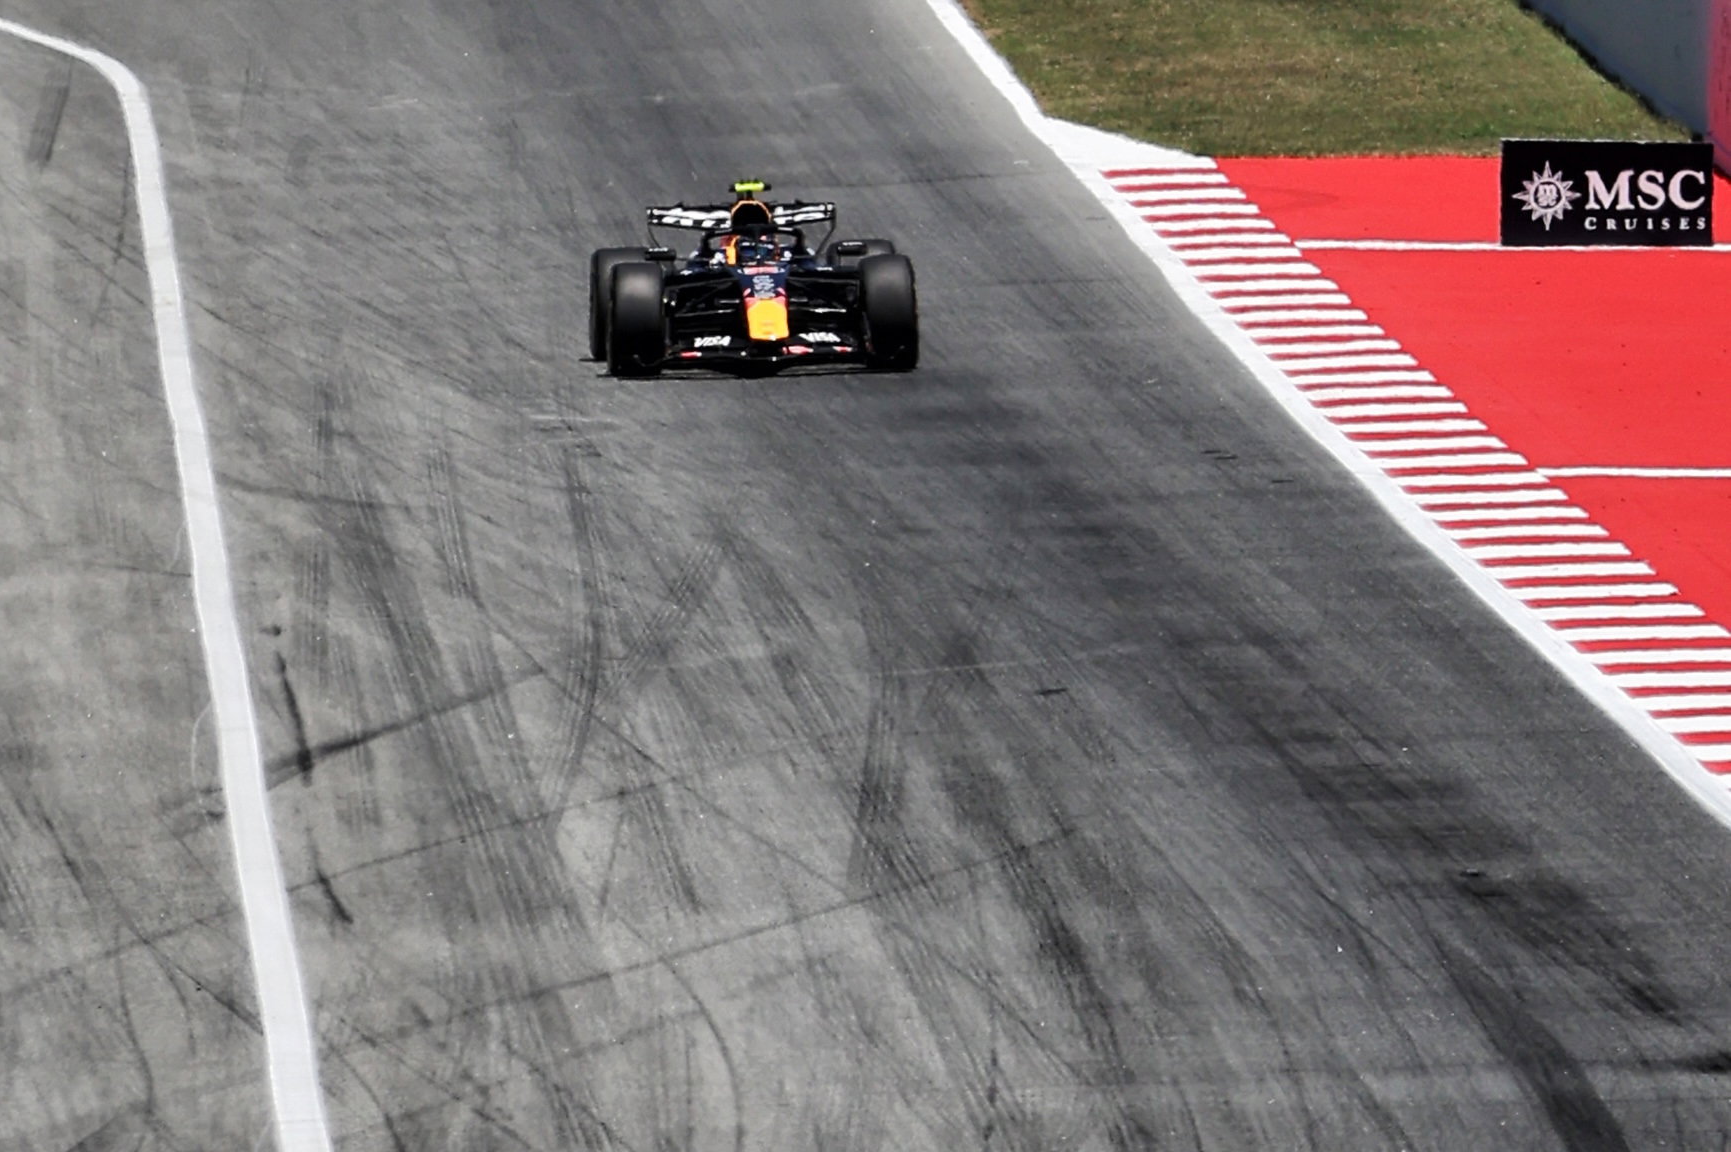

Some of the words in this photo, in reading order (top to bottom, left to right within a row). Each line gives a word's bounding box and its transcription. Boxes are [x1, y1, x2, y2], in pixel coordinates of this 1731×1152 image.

[1584, 169, 1706, 211] MSC
[1584, 216, 1706, 231] CRUISES
[694, 335, 732, 348] VISA
[798, 331, 841, 343] VISA
